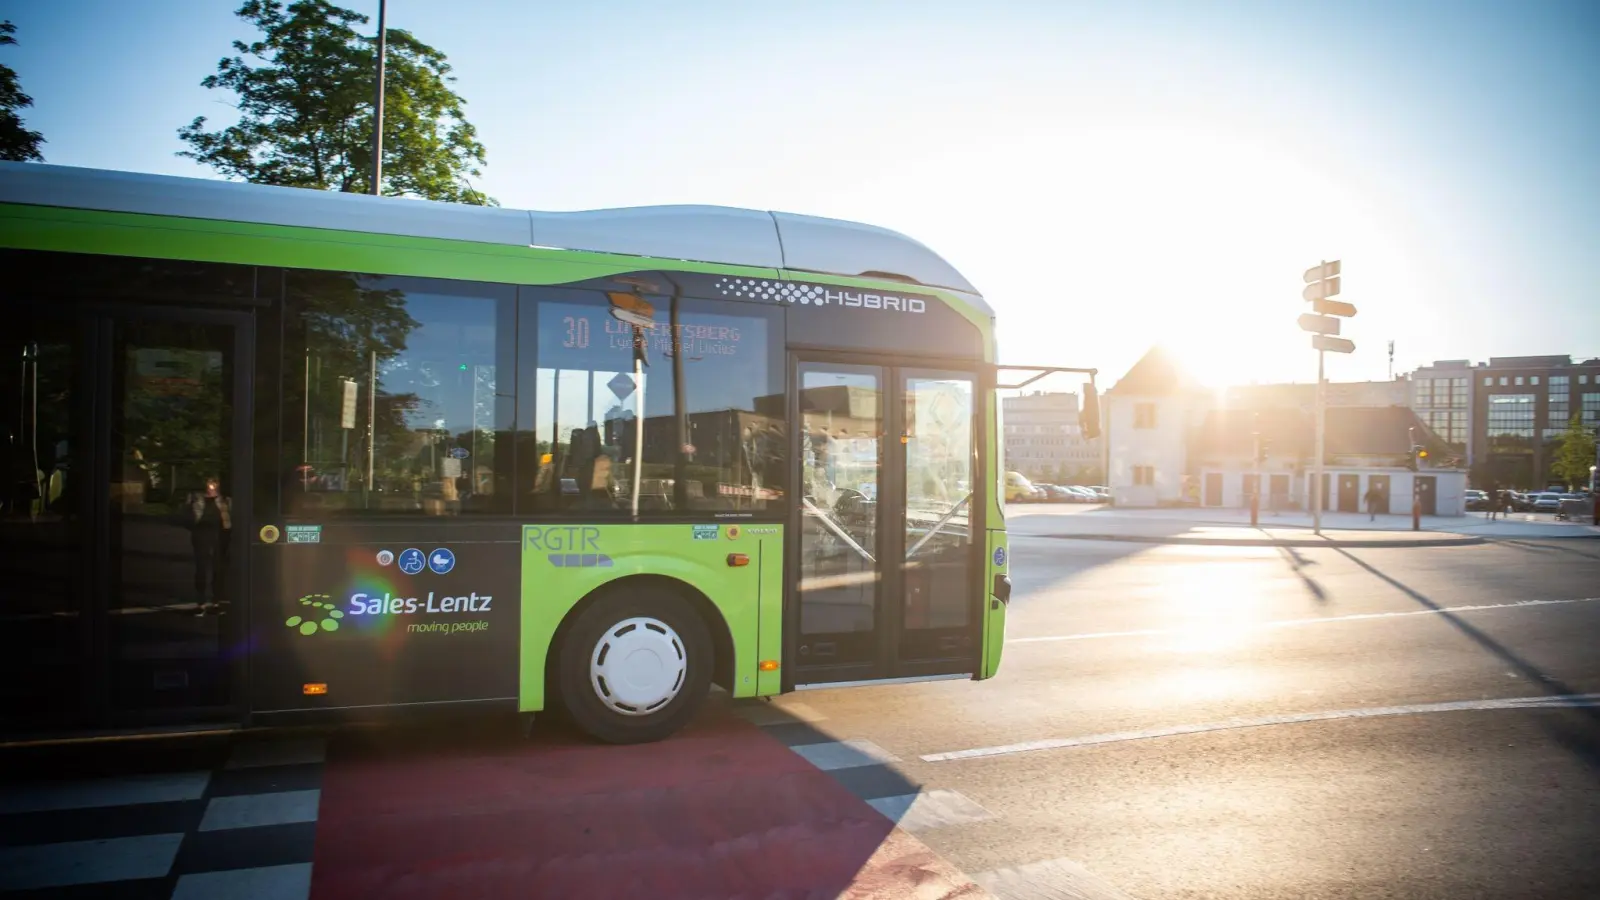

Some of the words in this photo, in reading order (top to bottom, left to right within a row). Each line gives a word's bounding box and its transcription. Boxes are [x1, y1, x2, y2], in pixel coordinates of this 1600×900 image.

[824, 290, 926, 313] HYBRID
[563, 316, 590, 349] 30
[523, 526, 600, 551] RGTR
[349, 591, 493, 615] Sales-Lentz
[407, 620, 450, 636] moving
[451, 619, 489, 634] people
